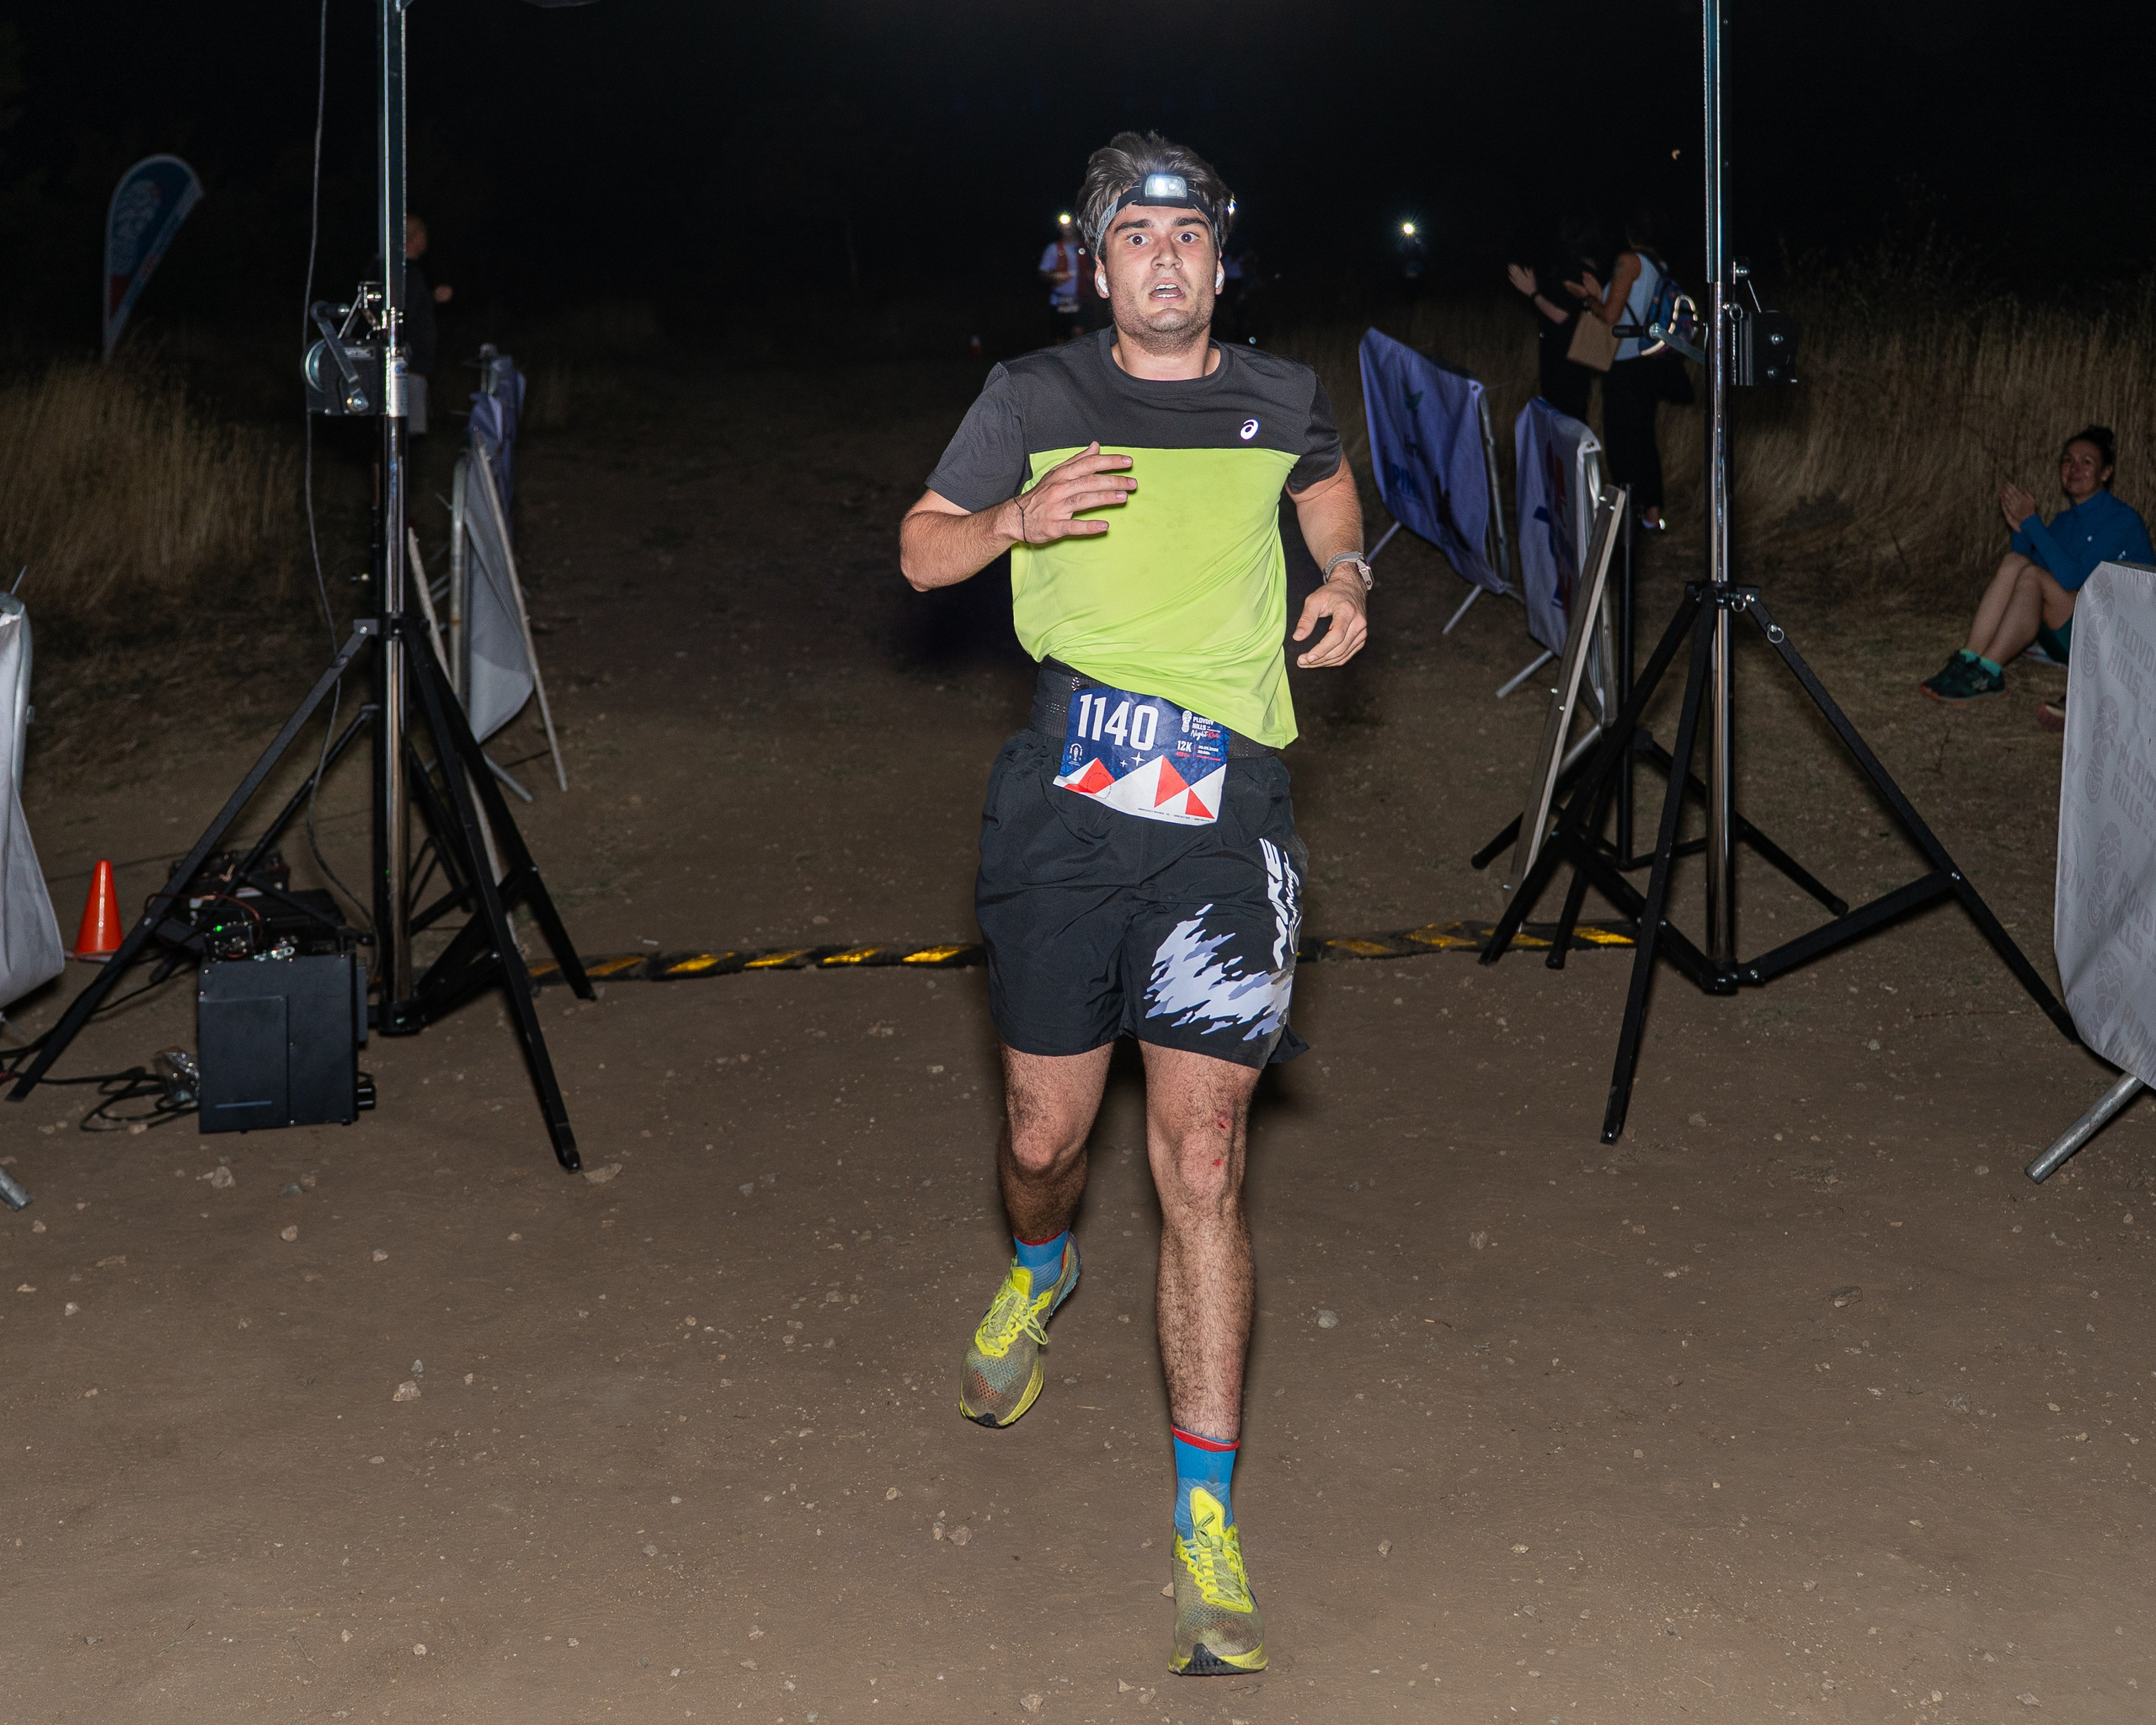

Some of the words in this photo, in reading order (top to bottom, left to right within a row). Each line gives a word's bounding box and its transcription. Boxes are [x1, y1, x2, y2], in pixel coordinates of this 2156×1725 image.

[2106, 645, 2143, 700] HILLS
[1077, 694, 1159, 751] 1140
[1190, 729, 1209, 741] Night
[1192, 723, 1207, 731] HILLS
[1193, 716, 1214, 726] PLOVDIV
[1177, 740, 1193, 753] 12K
[2110, 772, 2144, 830] HILLS
[1258, 837, 1289, 970] NIKE
